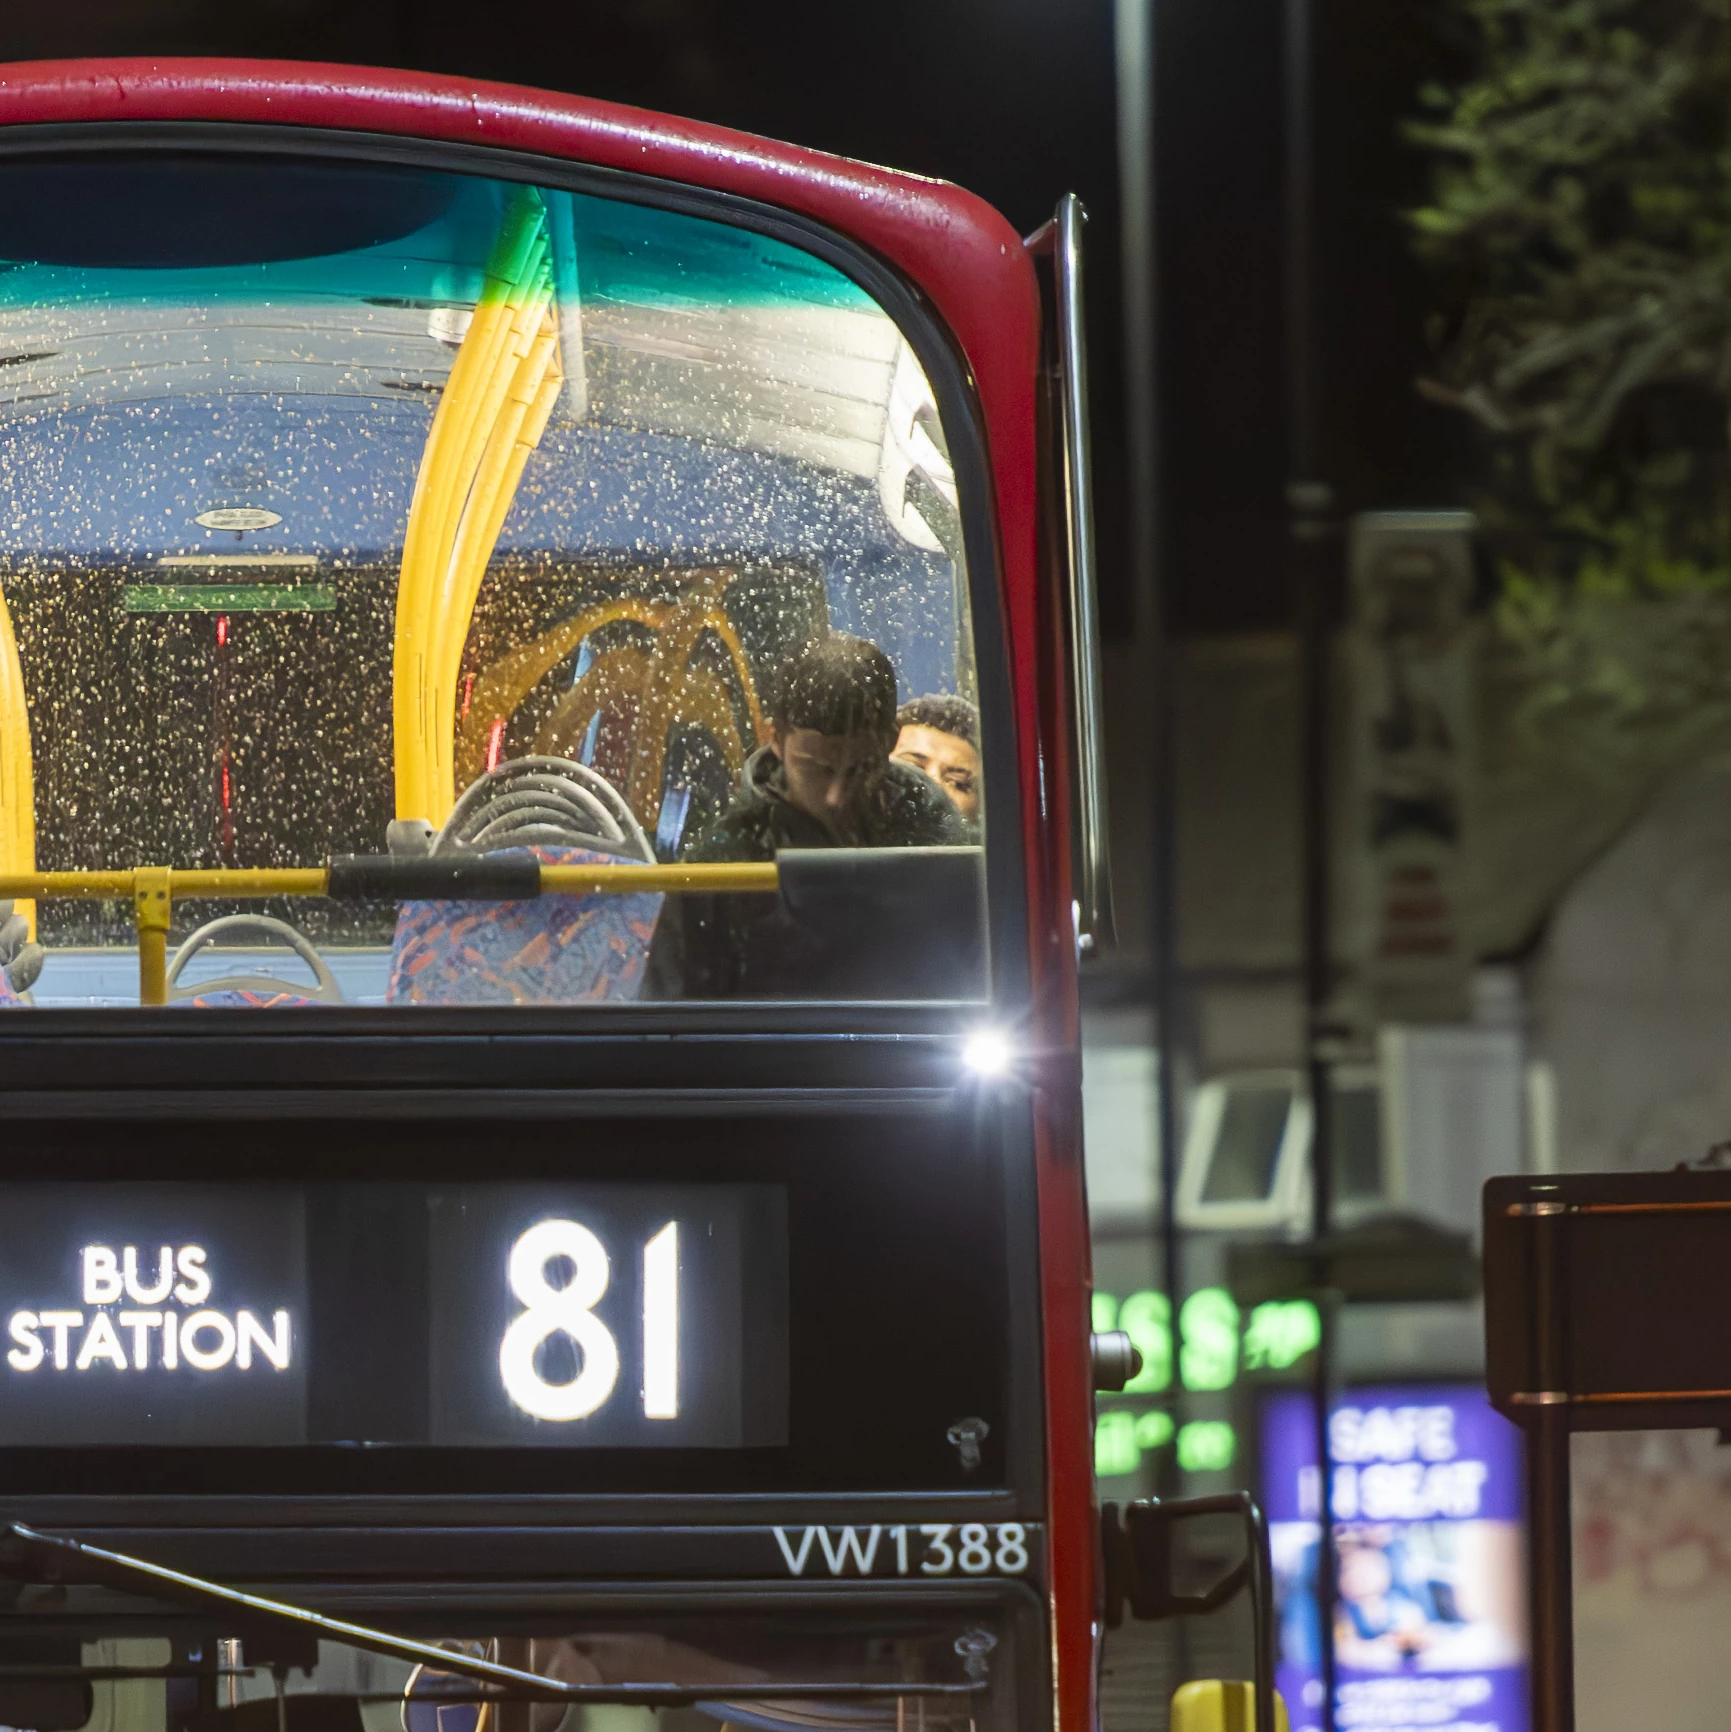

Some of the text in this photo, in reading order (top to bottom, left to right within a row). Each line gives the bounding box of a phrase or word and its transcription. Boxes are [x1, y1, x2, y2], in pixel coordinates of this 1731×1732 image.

[80, 1246, 211, 1305] BUS
[7, 1310, 291, 1371] STATION
[499, 1219, 682, 1421] 81
[772, 1523, 1029, 1575] VW1388
